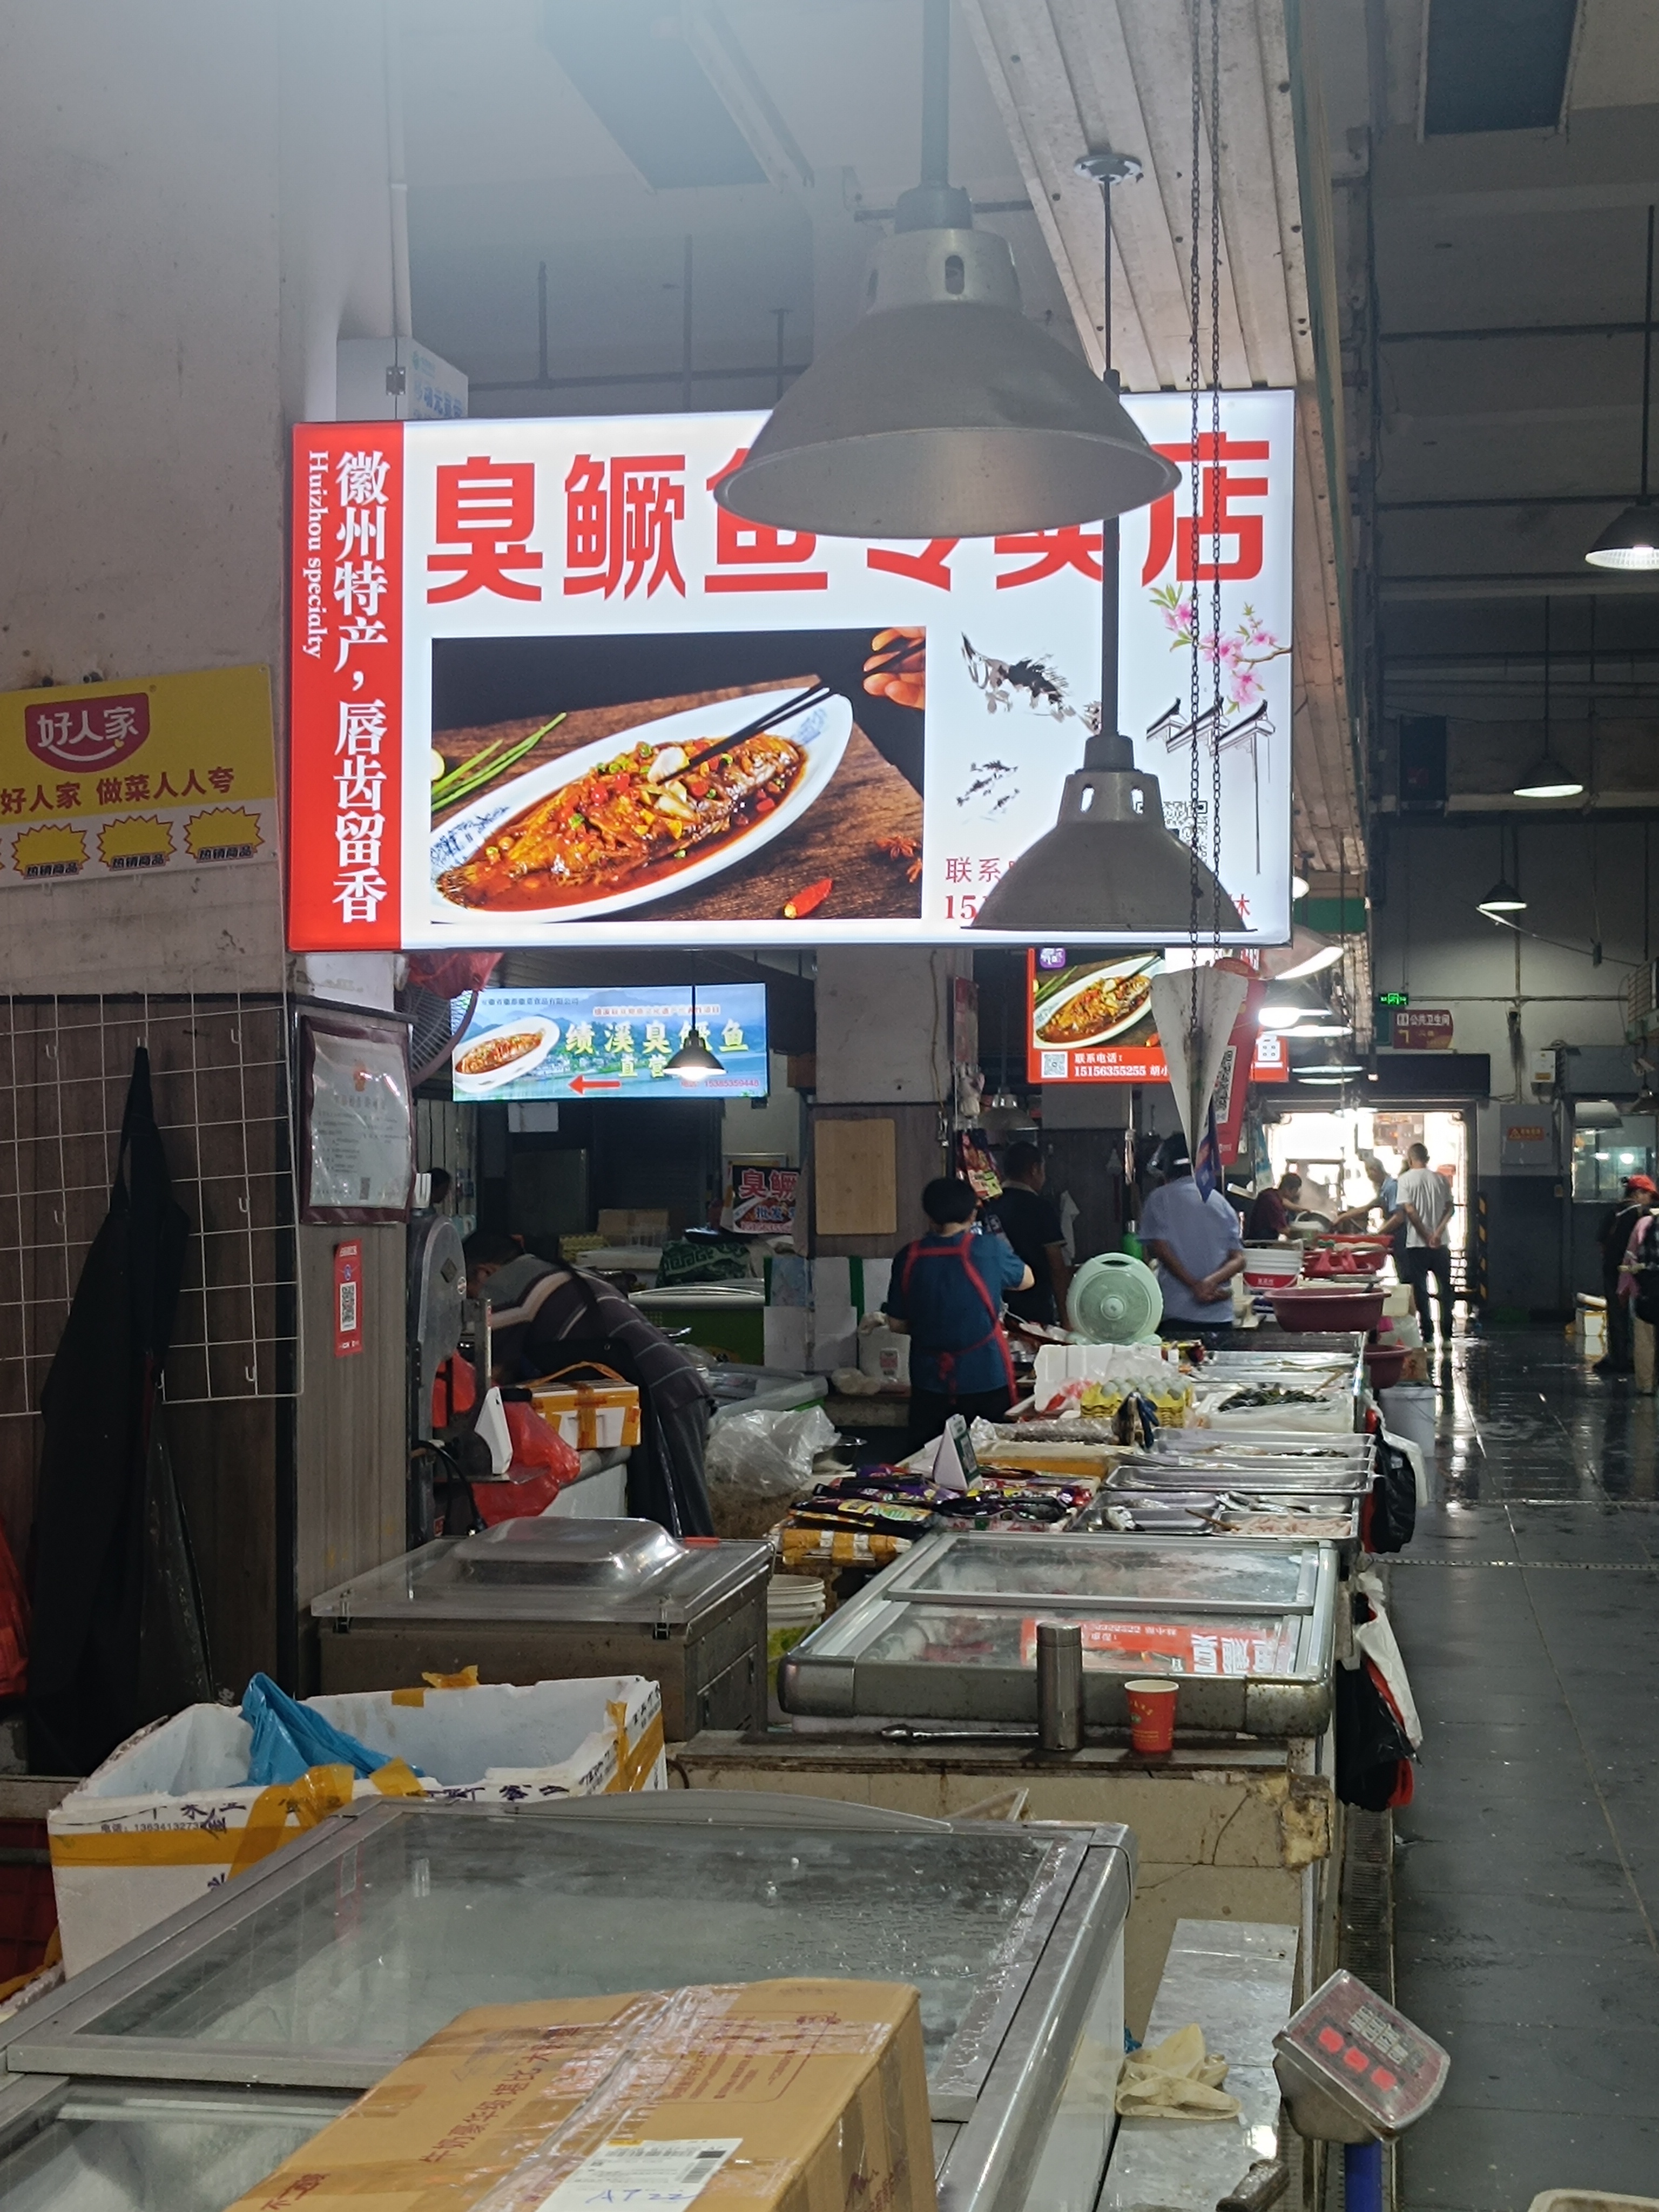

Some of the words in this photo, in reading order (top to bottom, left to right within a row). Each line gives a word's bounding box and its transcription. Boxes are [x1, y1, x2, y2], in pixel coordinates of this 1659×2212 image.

[308, 450, 329, 551] Huizhou
[303, 557, 328, 659] specialty
[333, 450, 390, 922] 徽州特产，唇齿留香
[37, 707, 138, 747] 好人家
[1, 782, 82, 814] 好人家
[97, 766, 234, 805] 做菜人人夸
[1410, 1014, 1450, 1026] 公共卫生间
[1075, 1065, 1147, 1077] 15156355255
